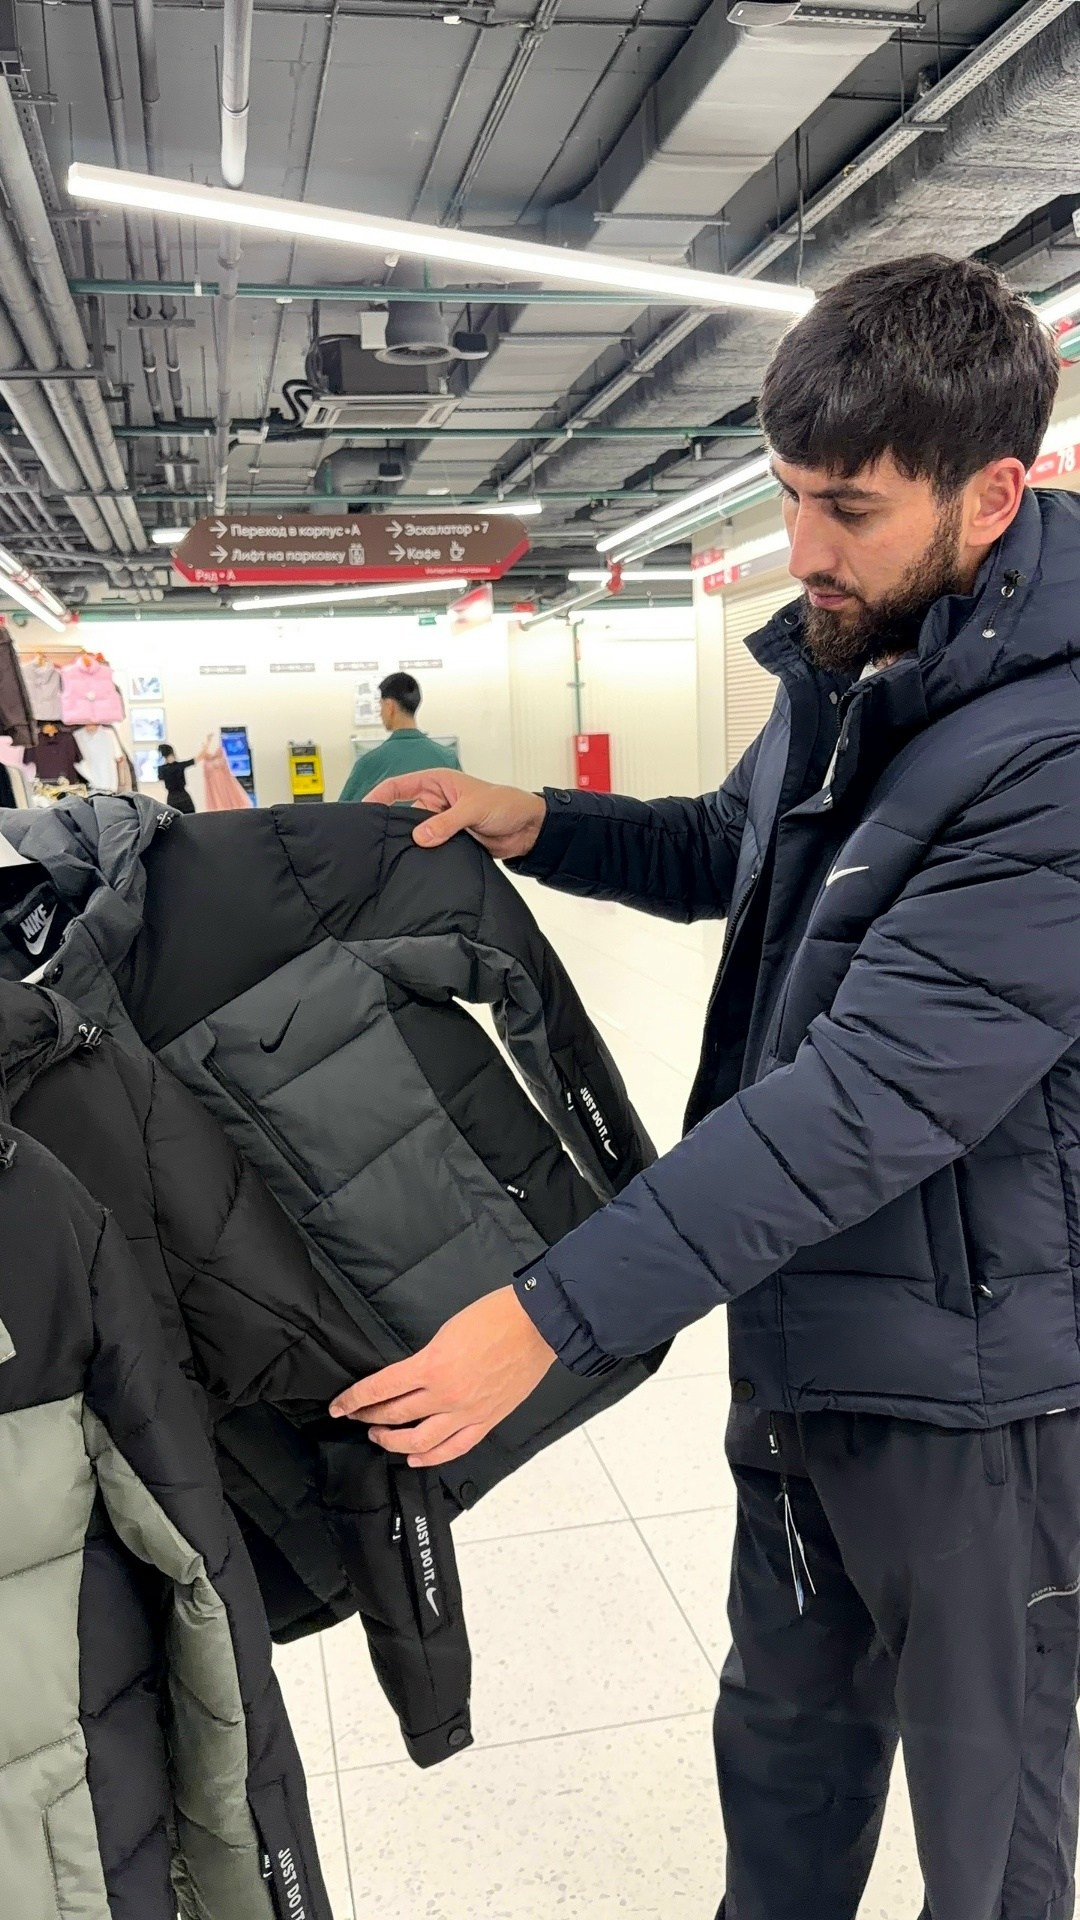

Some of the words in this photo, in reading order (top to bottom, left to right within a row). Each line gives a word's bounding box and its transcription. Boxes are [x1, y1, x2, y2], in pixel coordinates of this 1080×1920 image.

[230, 523, 288, 540] Переход
[288, 526, 298, 537] в
[231, 547, 266, 564] Лифт
[267, 550, 285, 562] на
[286, 550, 347, 565] парковку
[406, 546, 442, 561] Кафе
[20, 903, 47, 939] NIKE
[580, 1087, 597, 1112] JUST
[591, 1110, 604, 1128] DO
[414, 1515, 430, 1547] JUST
[420, 1547, 434, 1568] DO
[278, 1847, 298, 1885] JUST
[286, 1883, 302, 1909] DO
